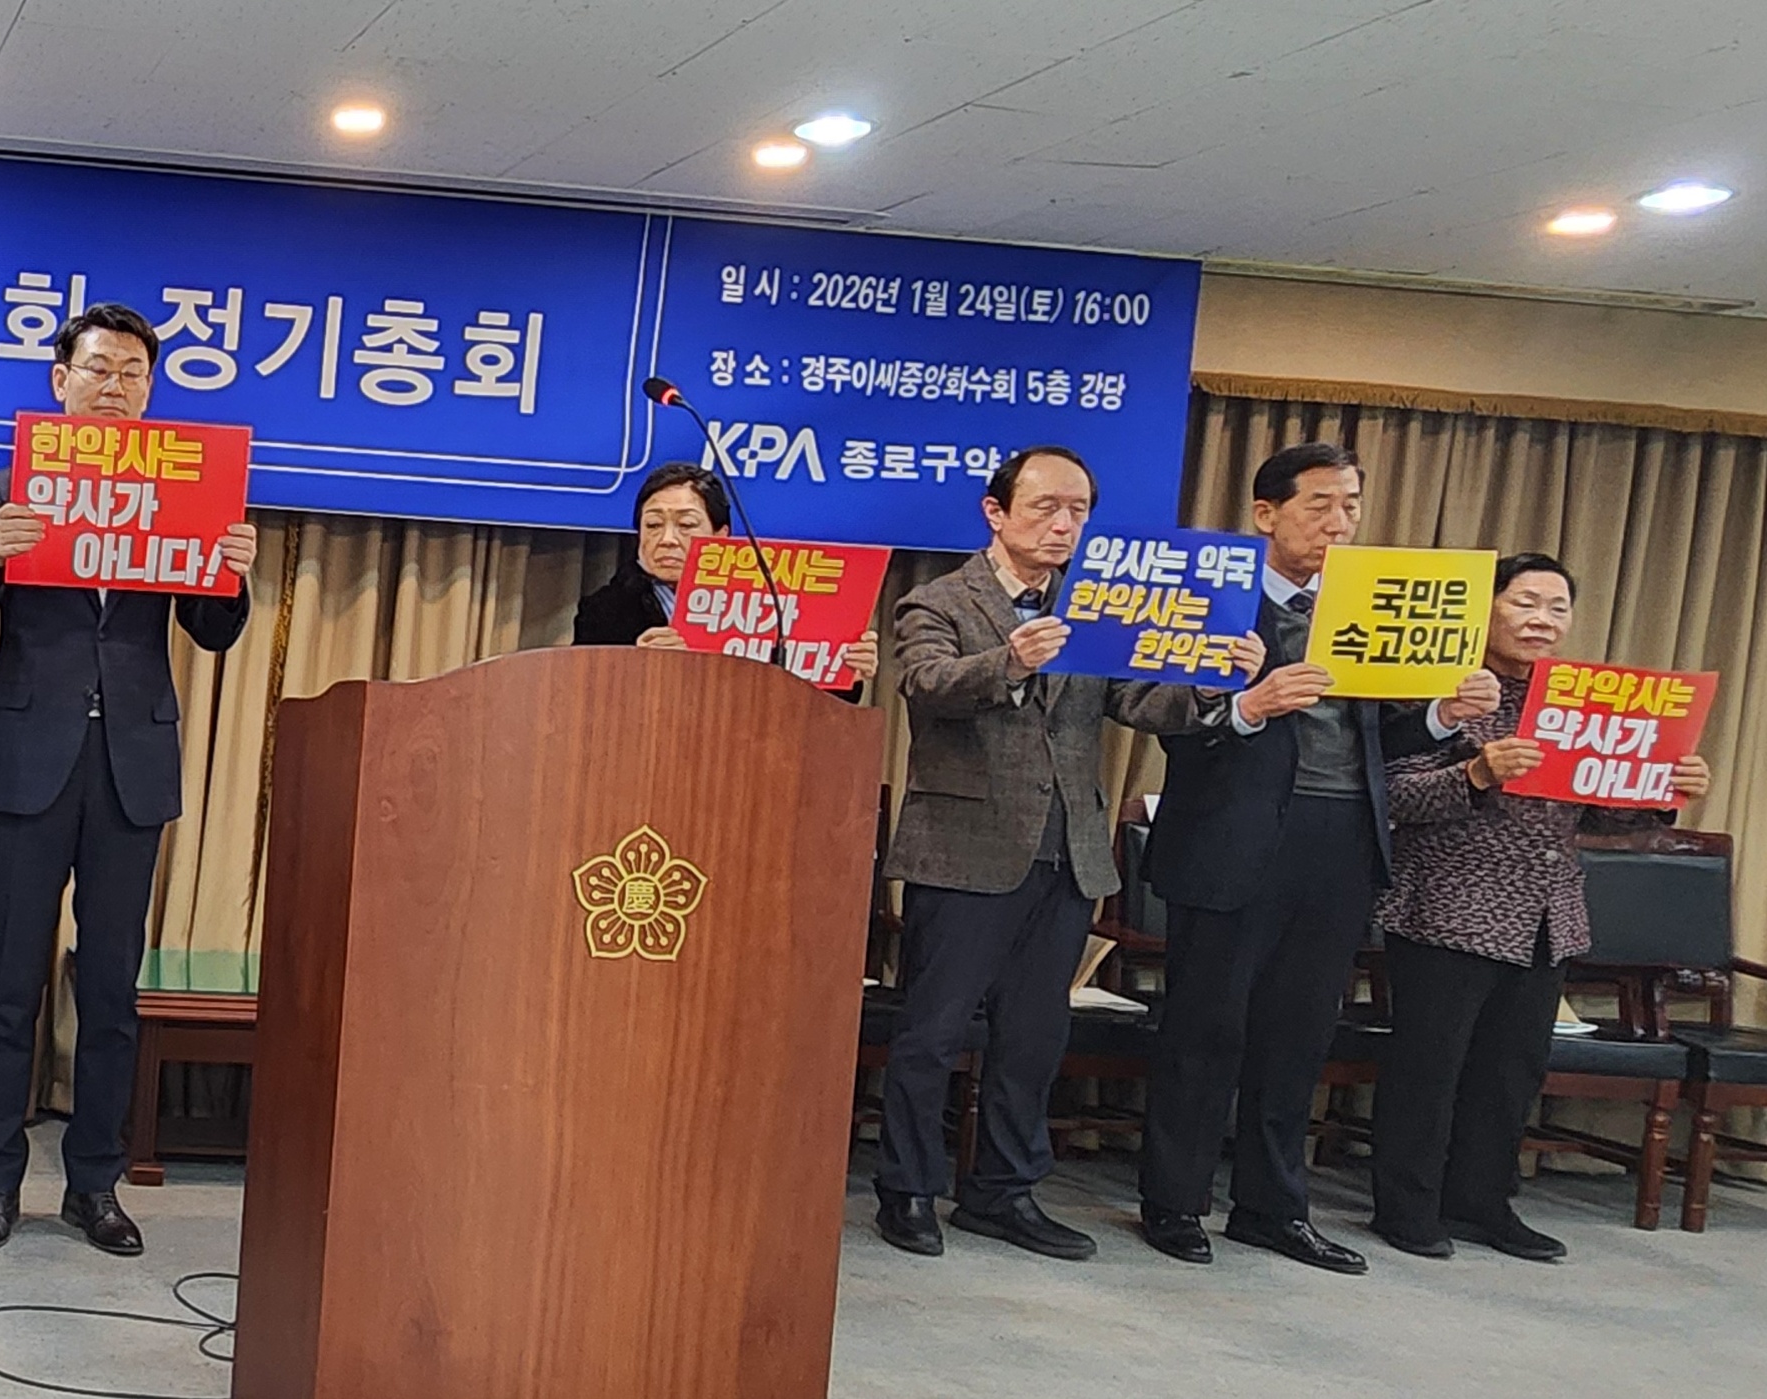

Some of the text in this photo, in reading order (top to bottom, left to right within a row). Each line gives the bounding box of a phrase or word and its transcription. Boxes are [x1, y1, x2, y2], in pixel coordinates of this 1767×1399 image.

[806, 271, 899, 315] 2026년
[910, 280, 950, 318] 1월
[957, 282, 1065, 325] 24일(토)
[1072, 289, 1150, 326] 16:00
[156, 285, 544, 416] 정기총회
[799, 354, 1018, 405] 경주이씨중앙화수회
[1027, 369, 1072, 405] 5층
[1078, 371, 1128, 411] 강당
[31, 421, 203, 482] 한약사는
[700, 420, 827, 483] KPA
[839, 438, 1023, 487] 종로구약
[27, 475, 159, 531] 약사가
[73, 532, 224, 588] 아니다!
[694, 543, 845, 593] 한약사는
[1083, 536, 1256, 590] 약사는 약국
[686, 588, 799, 636] 약사가
[1065, 579, 1210, 630] 한약사는
[1371, 578, 1469, 621] 국민은
[1128, 629, 1237, 677] 한약국
[1331, 623, 1481, 667] 속고있다!
[1544, 664, 1696, 717] 한약사는
[1534, 707, 1659, 758] 약사가
